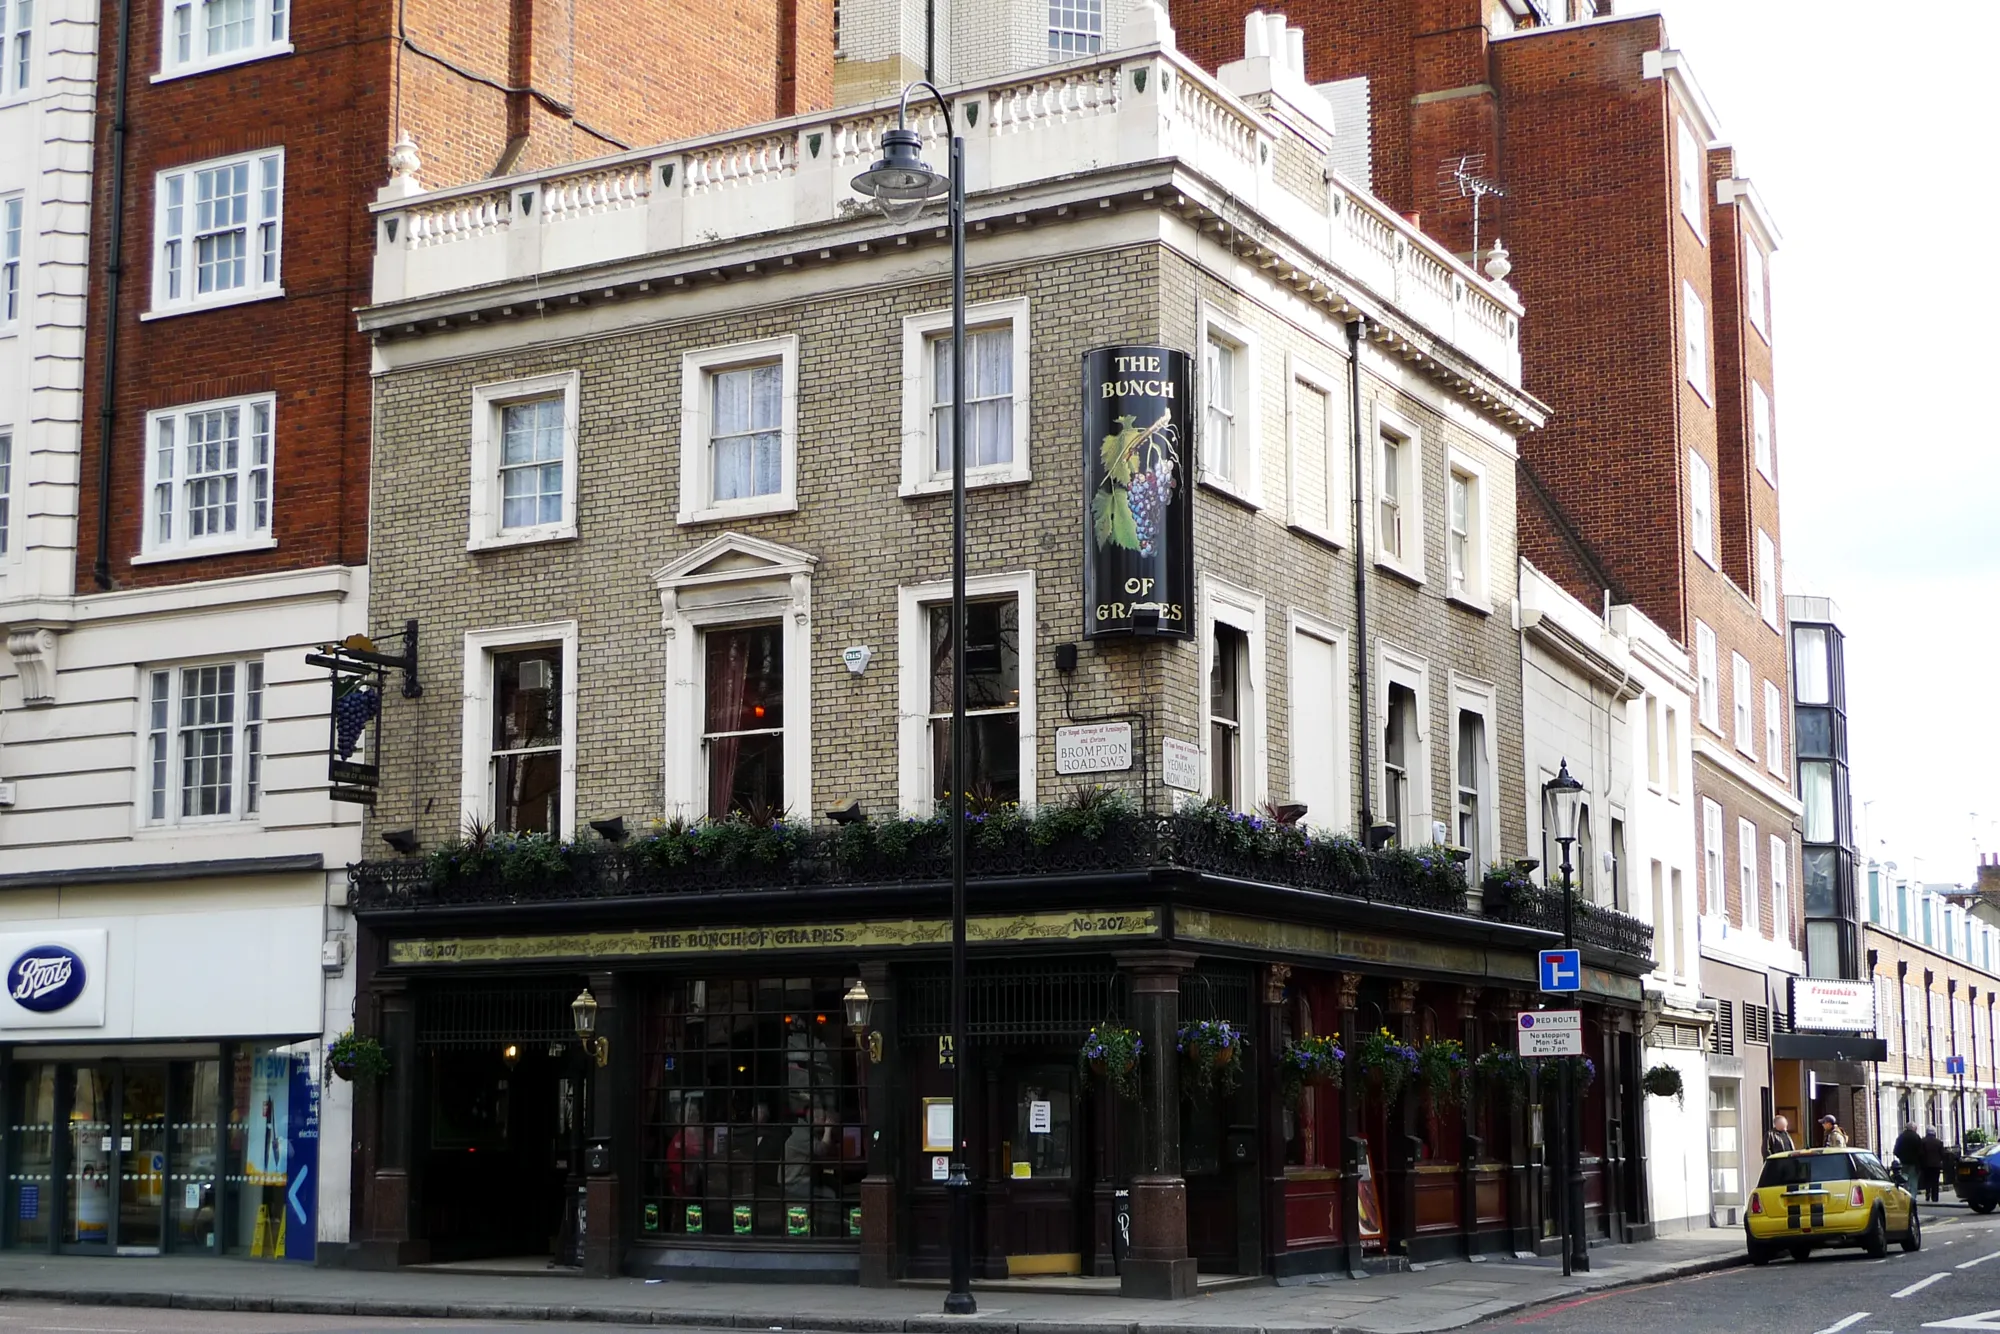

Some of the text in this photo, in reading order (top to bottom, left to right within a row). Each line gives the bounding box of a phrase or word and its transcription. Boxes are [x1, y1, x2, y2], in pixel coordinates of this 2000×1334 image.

[1115, 356, 1160, 373] THE
[1102, 380, 1174, 399] BUNCH
[1125, 577, 1155, 597] OF
[1096, 602, 1182, 621] GRES
[1061, 743, 1127, 758] BROMPTON
[1098, 916, 1124, 930] 207
[650, 928, 845, 949] THE BUNCH OF GRAPES
[437, 944, 458, 957] 207
[12, 956, 72, 999] Boots
[254, 1056, 286, 1079] new
